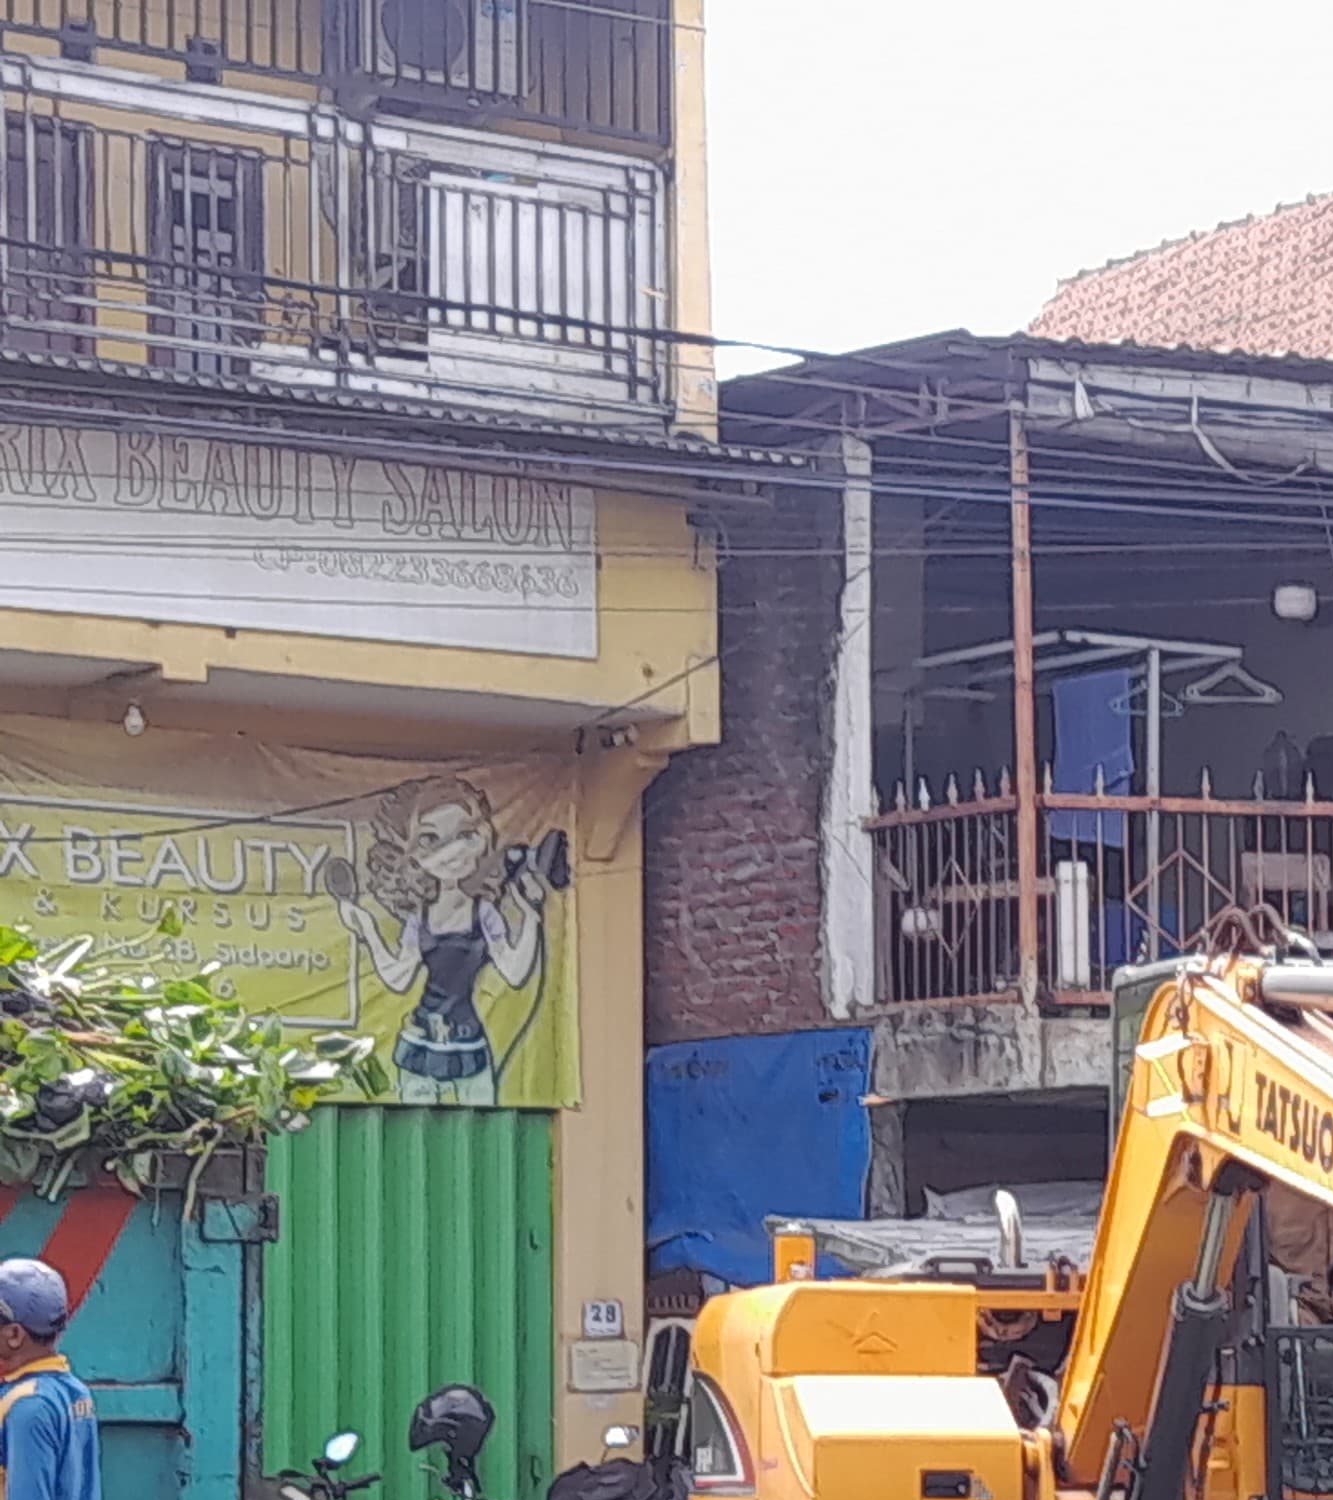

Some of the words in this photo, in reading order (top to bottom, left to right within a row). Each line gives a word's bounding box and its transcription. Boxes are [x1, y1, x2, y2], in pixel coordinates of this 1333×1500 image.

[62, 824, 331, 897] BEAUTY
[102, 890, 307, 934] KURSUS
[216, 943, 332, 975] Sidoarjo
[590, 1304, 616, 1323] 28
